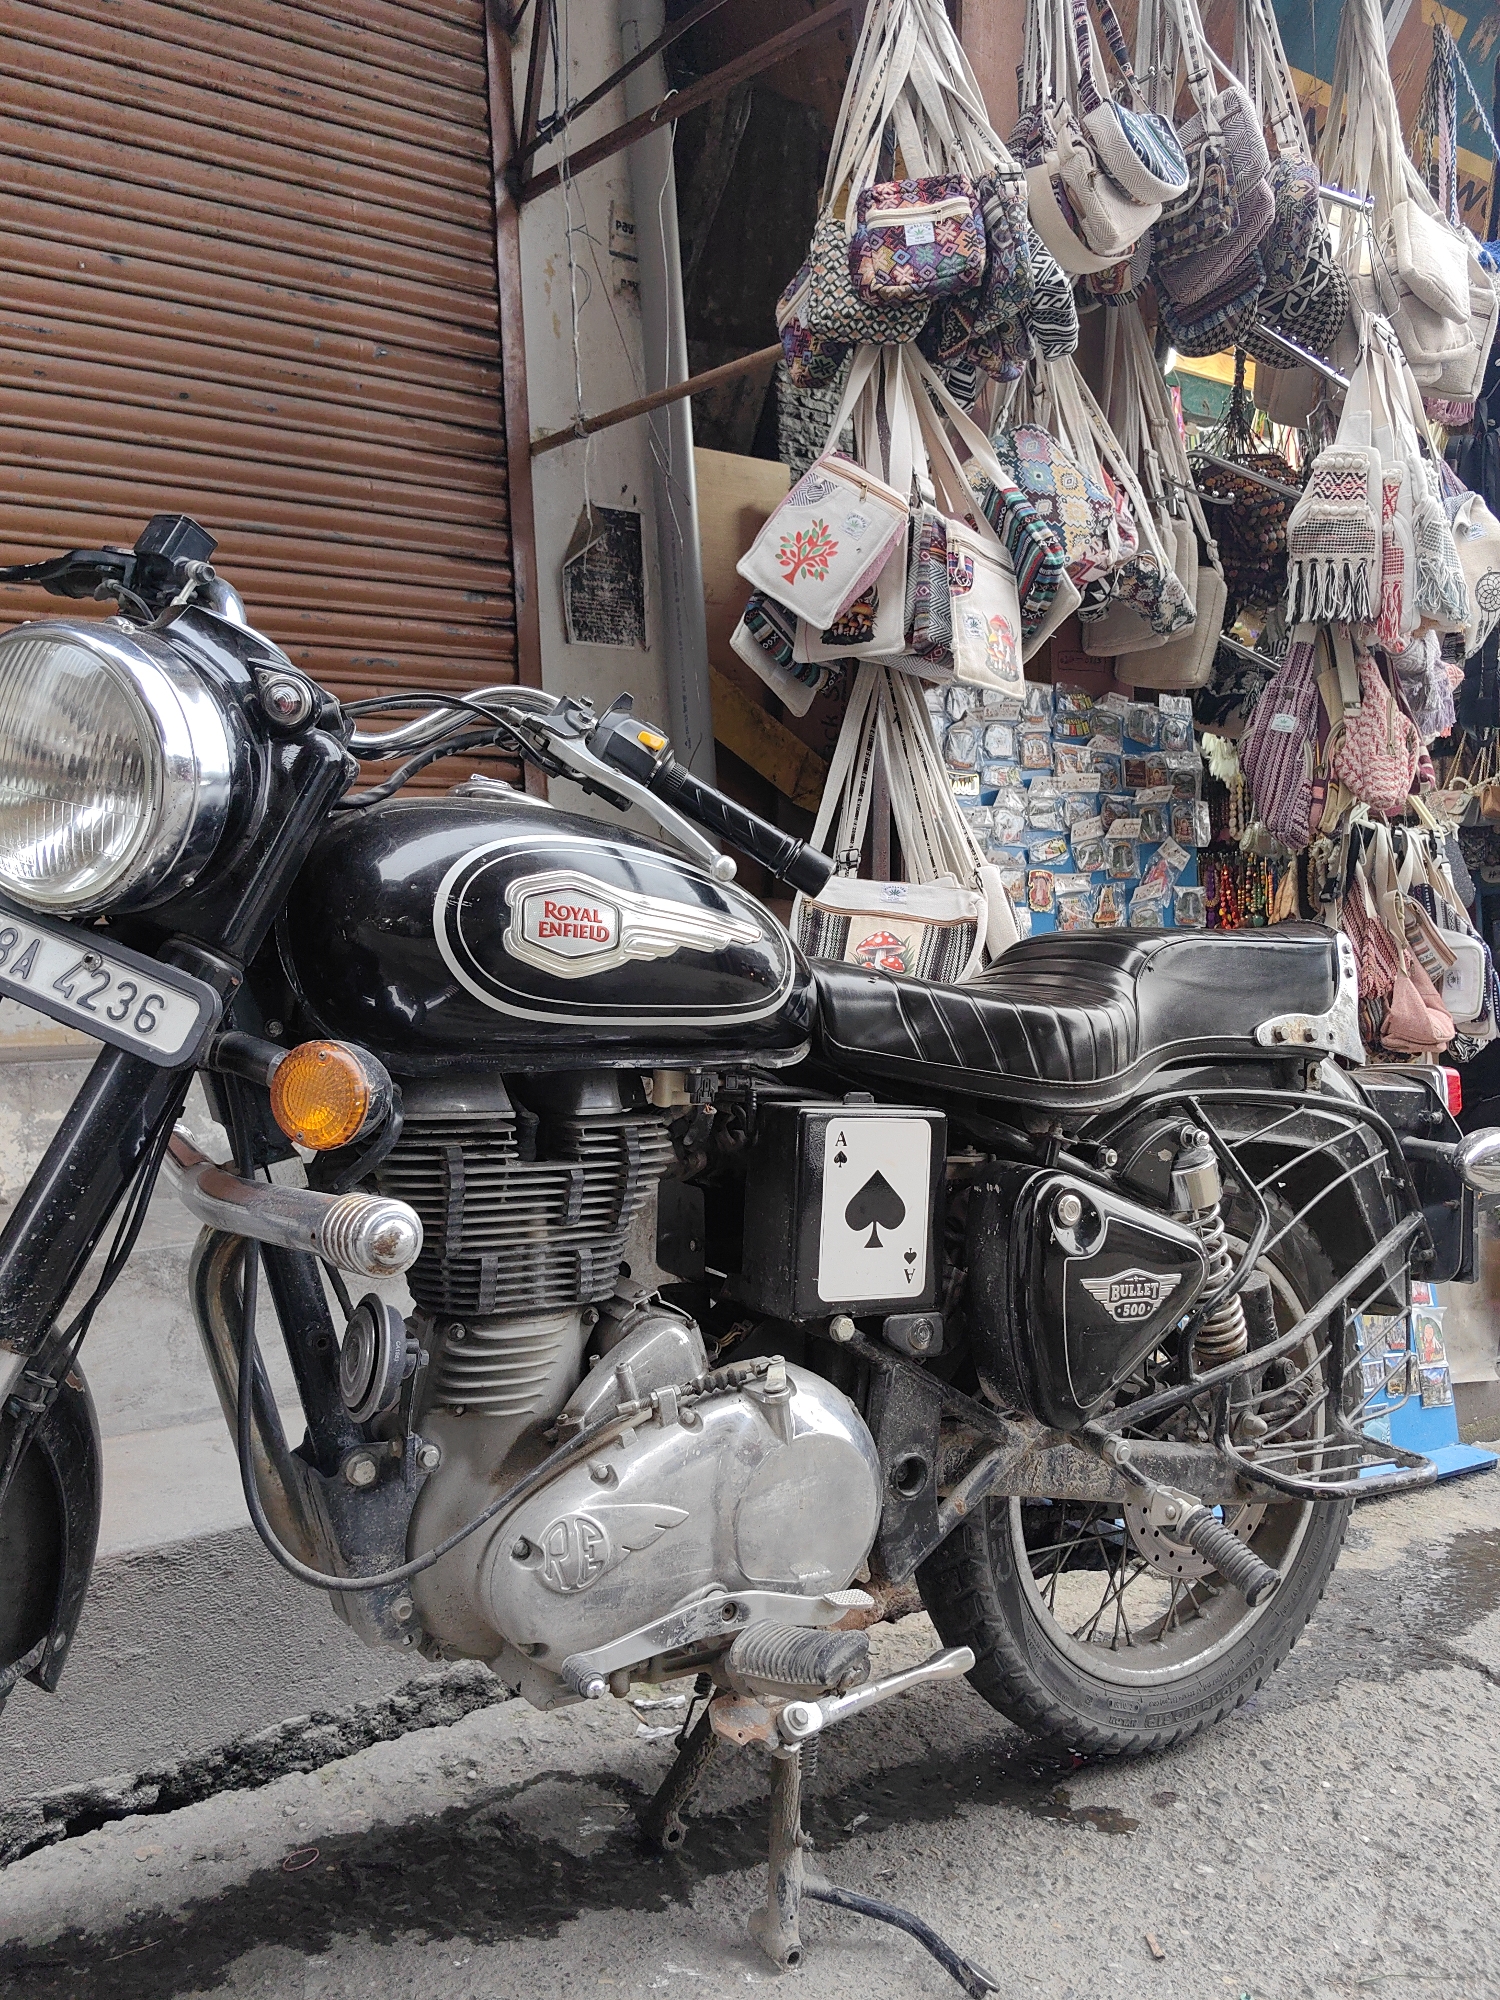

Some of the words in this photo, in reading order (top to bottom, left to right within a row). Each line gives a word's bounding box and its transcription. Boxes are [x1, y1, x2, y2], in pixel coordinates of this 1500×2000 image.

[544, 900, 603, 923] ROYAL
[538, 921, 610, 943] ENFIELD
[52, 959, 166, 1035] 4236
[834, 1130, 848, 1147] A
[903, 1268, 916, 1284] A
[1110, 1282, 1160, 1302] BULLET
[1122, 1302, 1146, 1317] 500
[543, 1516, 604, 1591] RE
